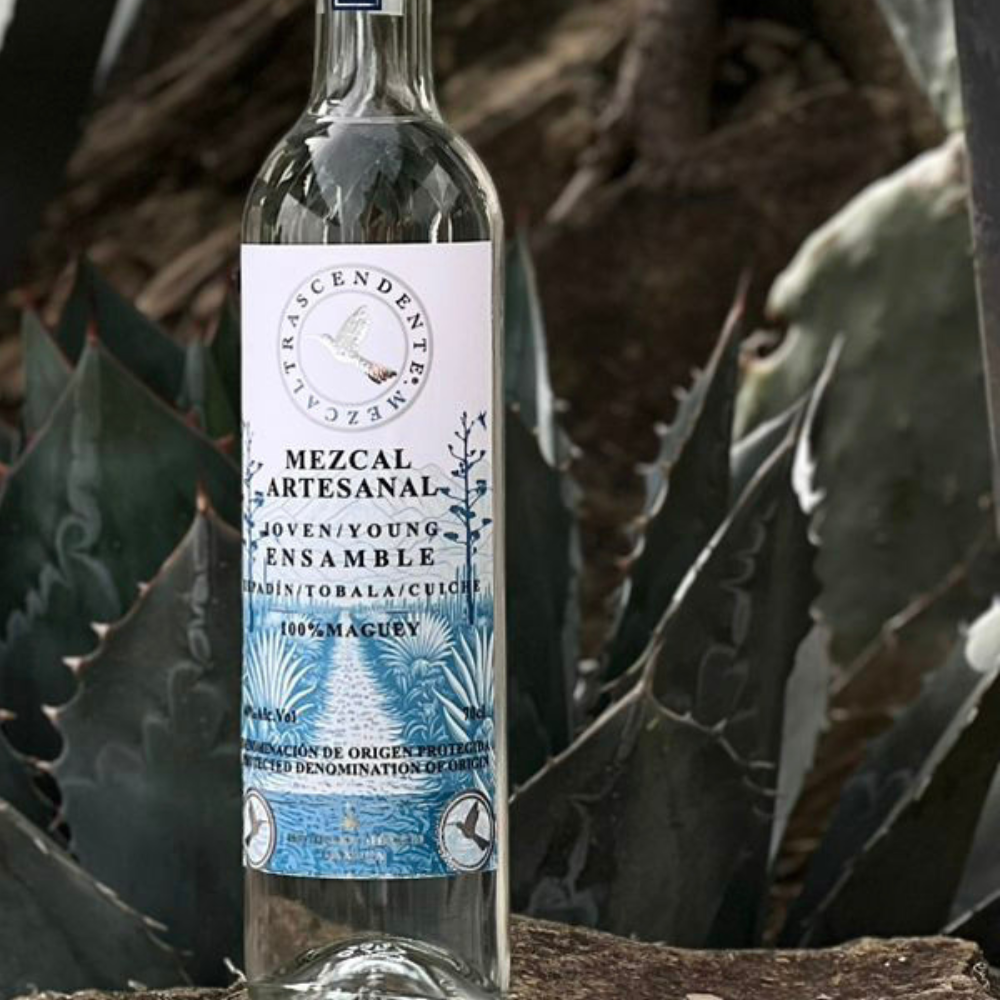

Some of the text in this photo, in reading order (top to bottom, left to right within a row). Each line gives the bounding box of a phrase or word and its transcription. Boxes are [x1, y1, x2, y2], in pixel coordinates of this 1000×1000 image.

[281, 270, 428, 426] MEZCAL TRASCENDENTE
[285, 448, 412, 470] MEZCAL
[266, 475, 440, 499] ARTESANAL
[266, 547, 436, 568] ENSAMBLE
[322, 745, 344, 759] DE
[347, 744, 413, 760] ORIGEN
[296, 760, 421, 776] DENOMINATION
[425, 760, 446, 774] OF
